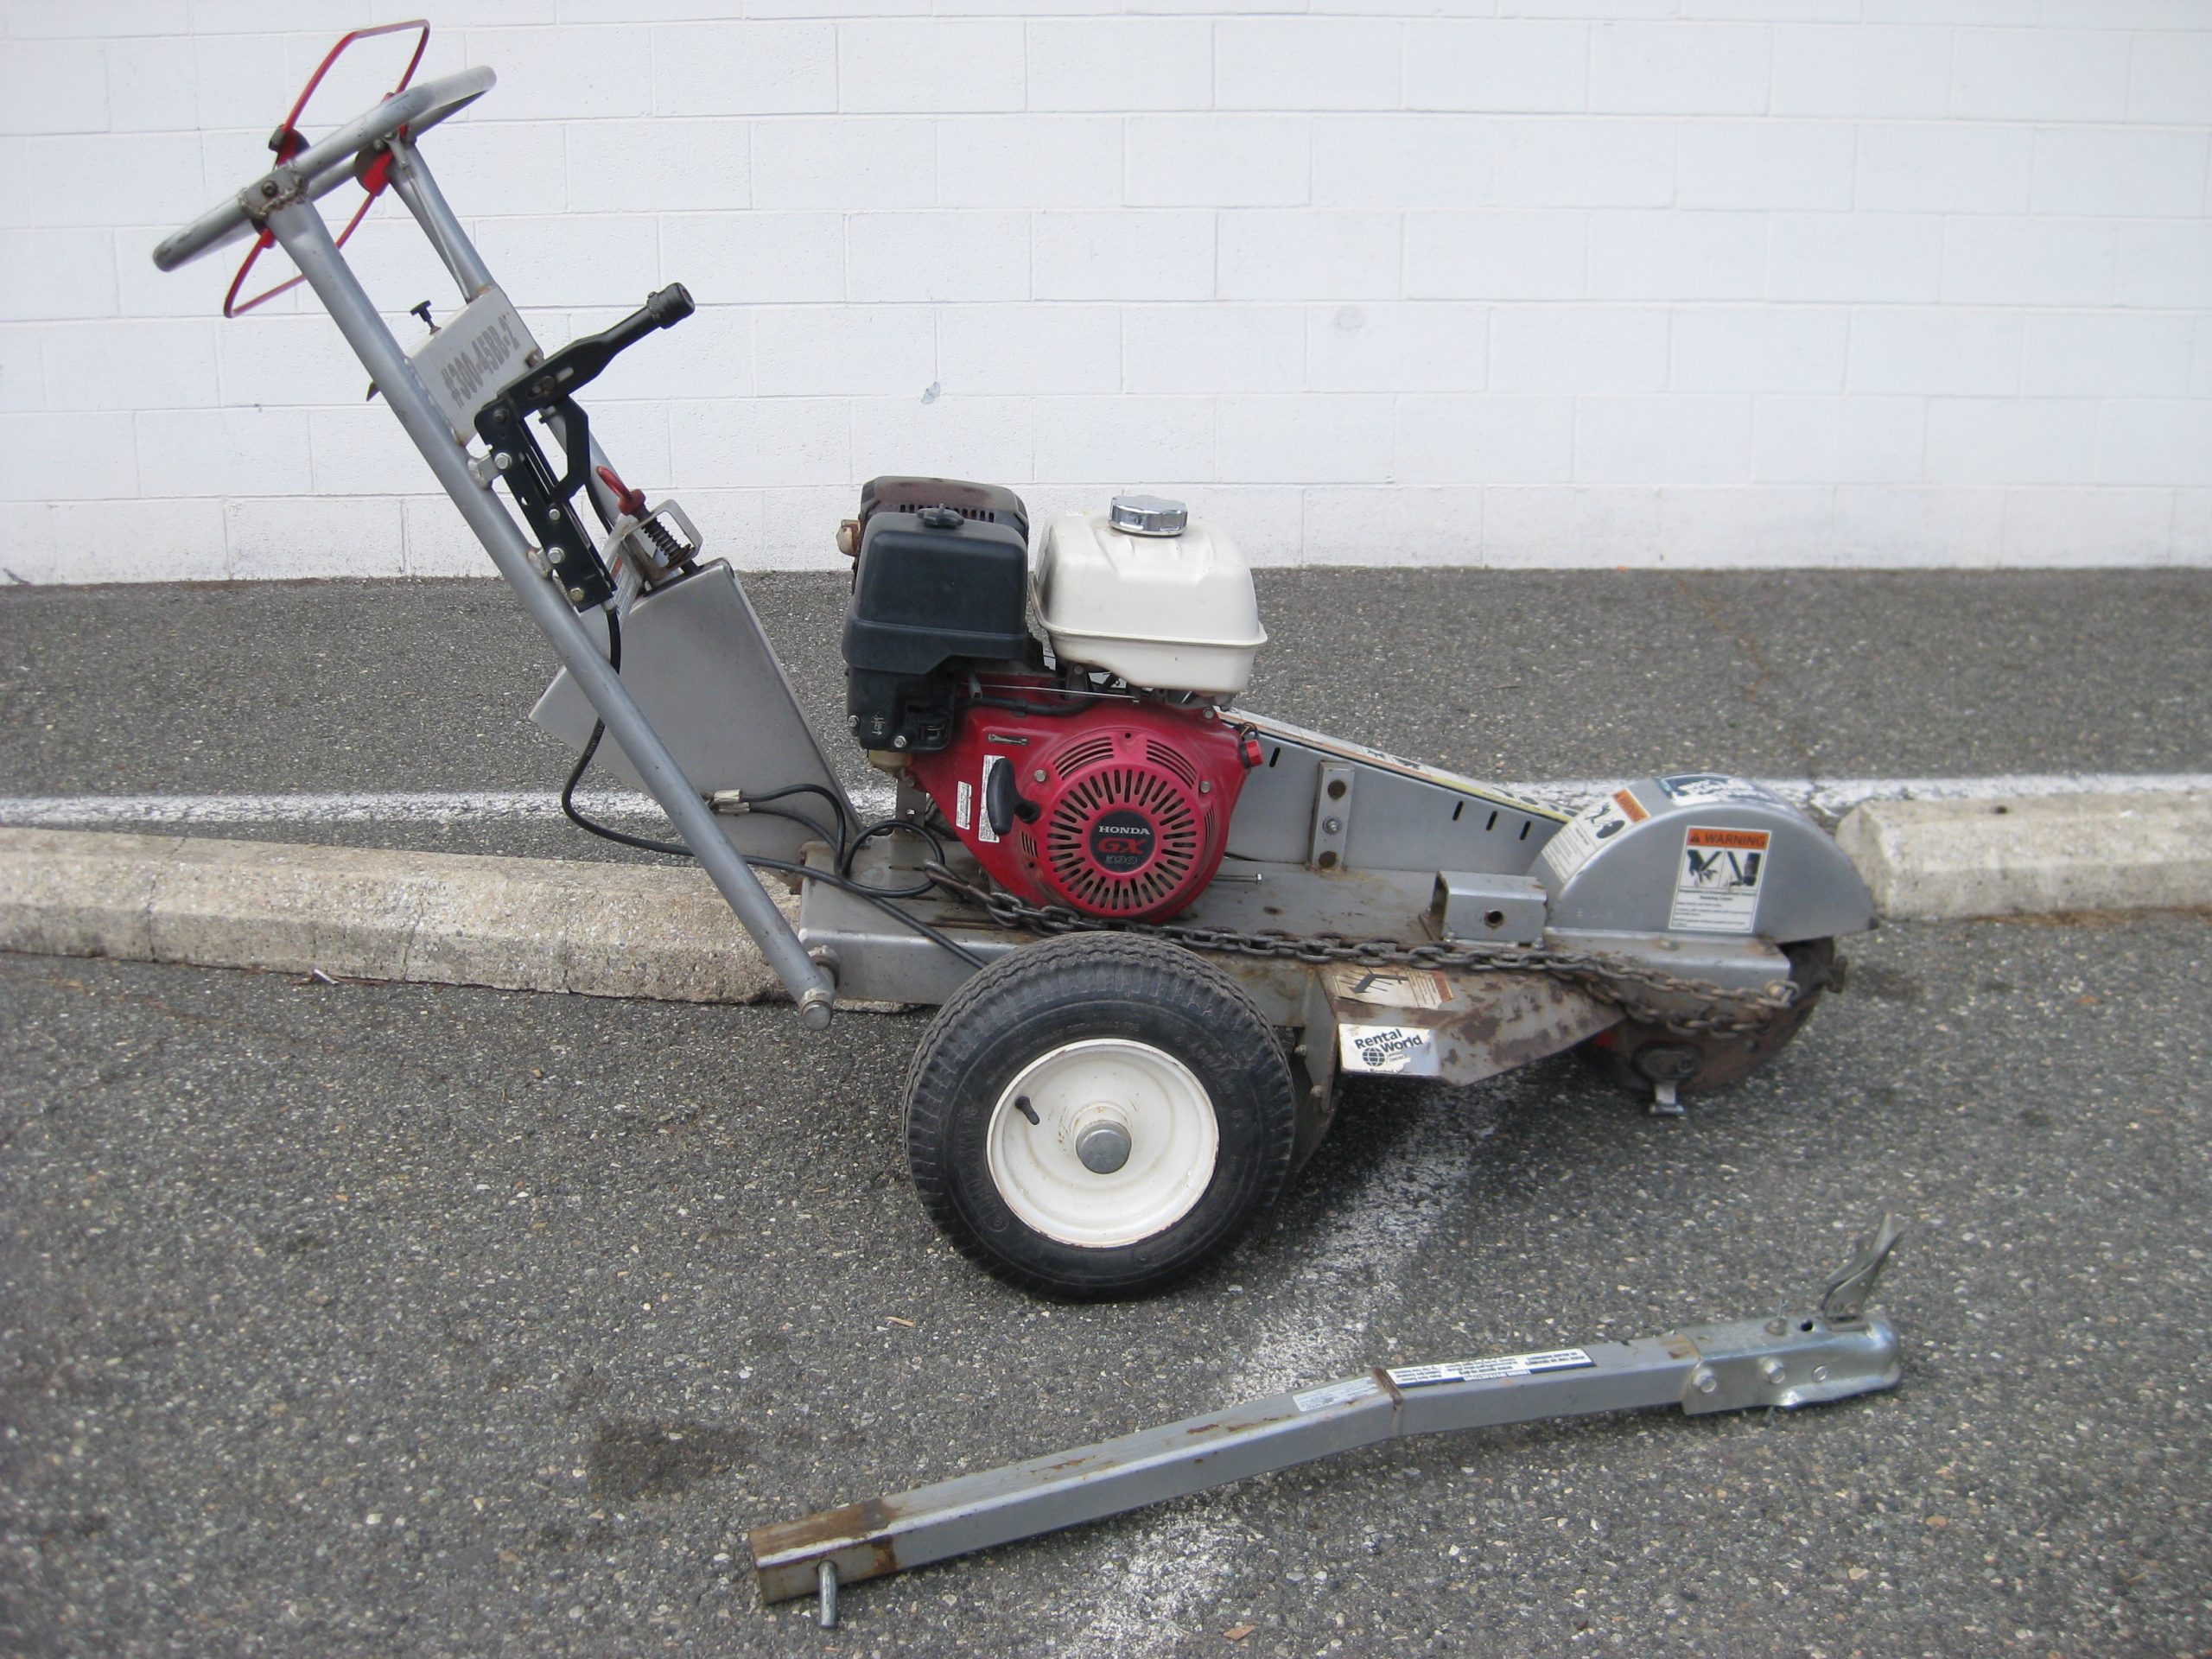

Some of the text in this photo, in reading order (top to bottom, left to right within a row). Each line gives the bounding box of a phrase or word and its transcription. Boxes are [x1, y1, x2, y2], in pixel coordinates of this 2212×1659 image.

[1098, 825, 1151, 836] HONDA
[1705, 832, 1765, 847] WARNING
[1097, 837, 1147, 855] GX
[1354, 1028, 1402, 1049] Rental
[1380, 1034, 1423, 1053] World
